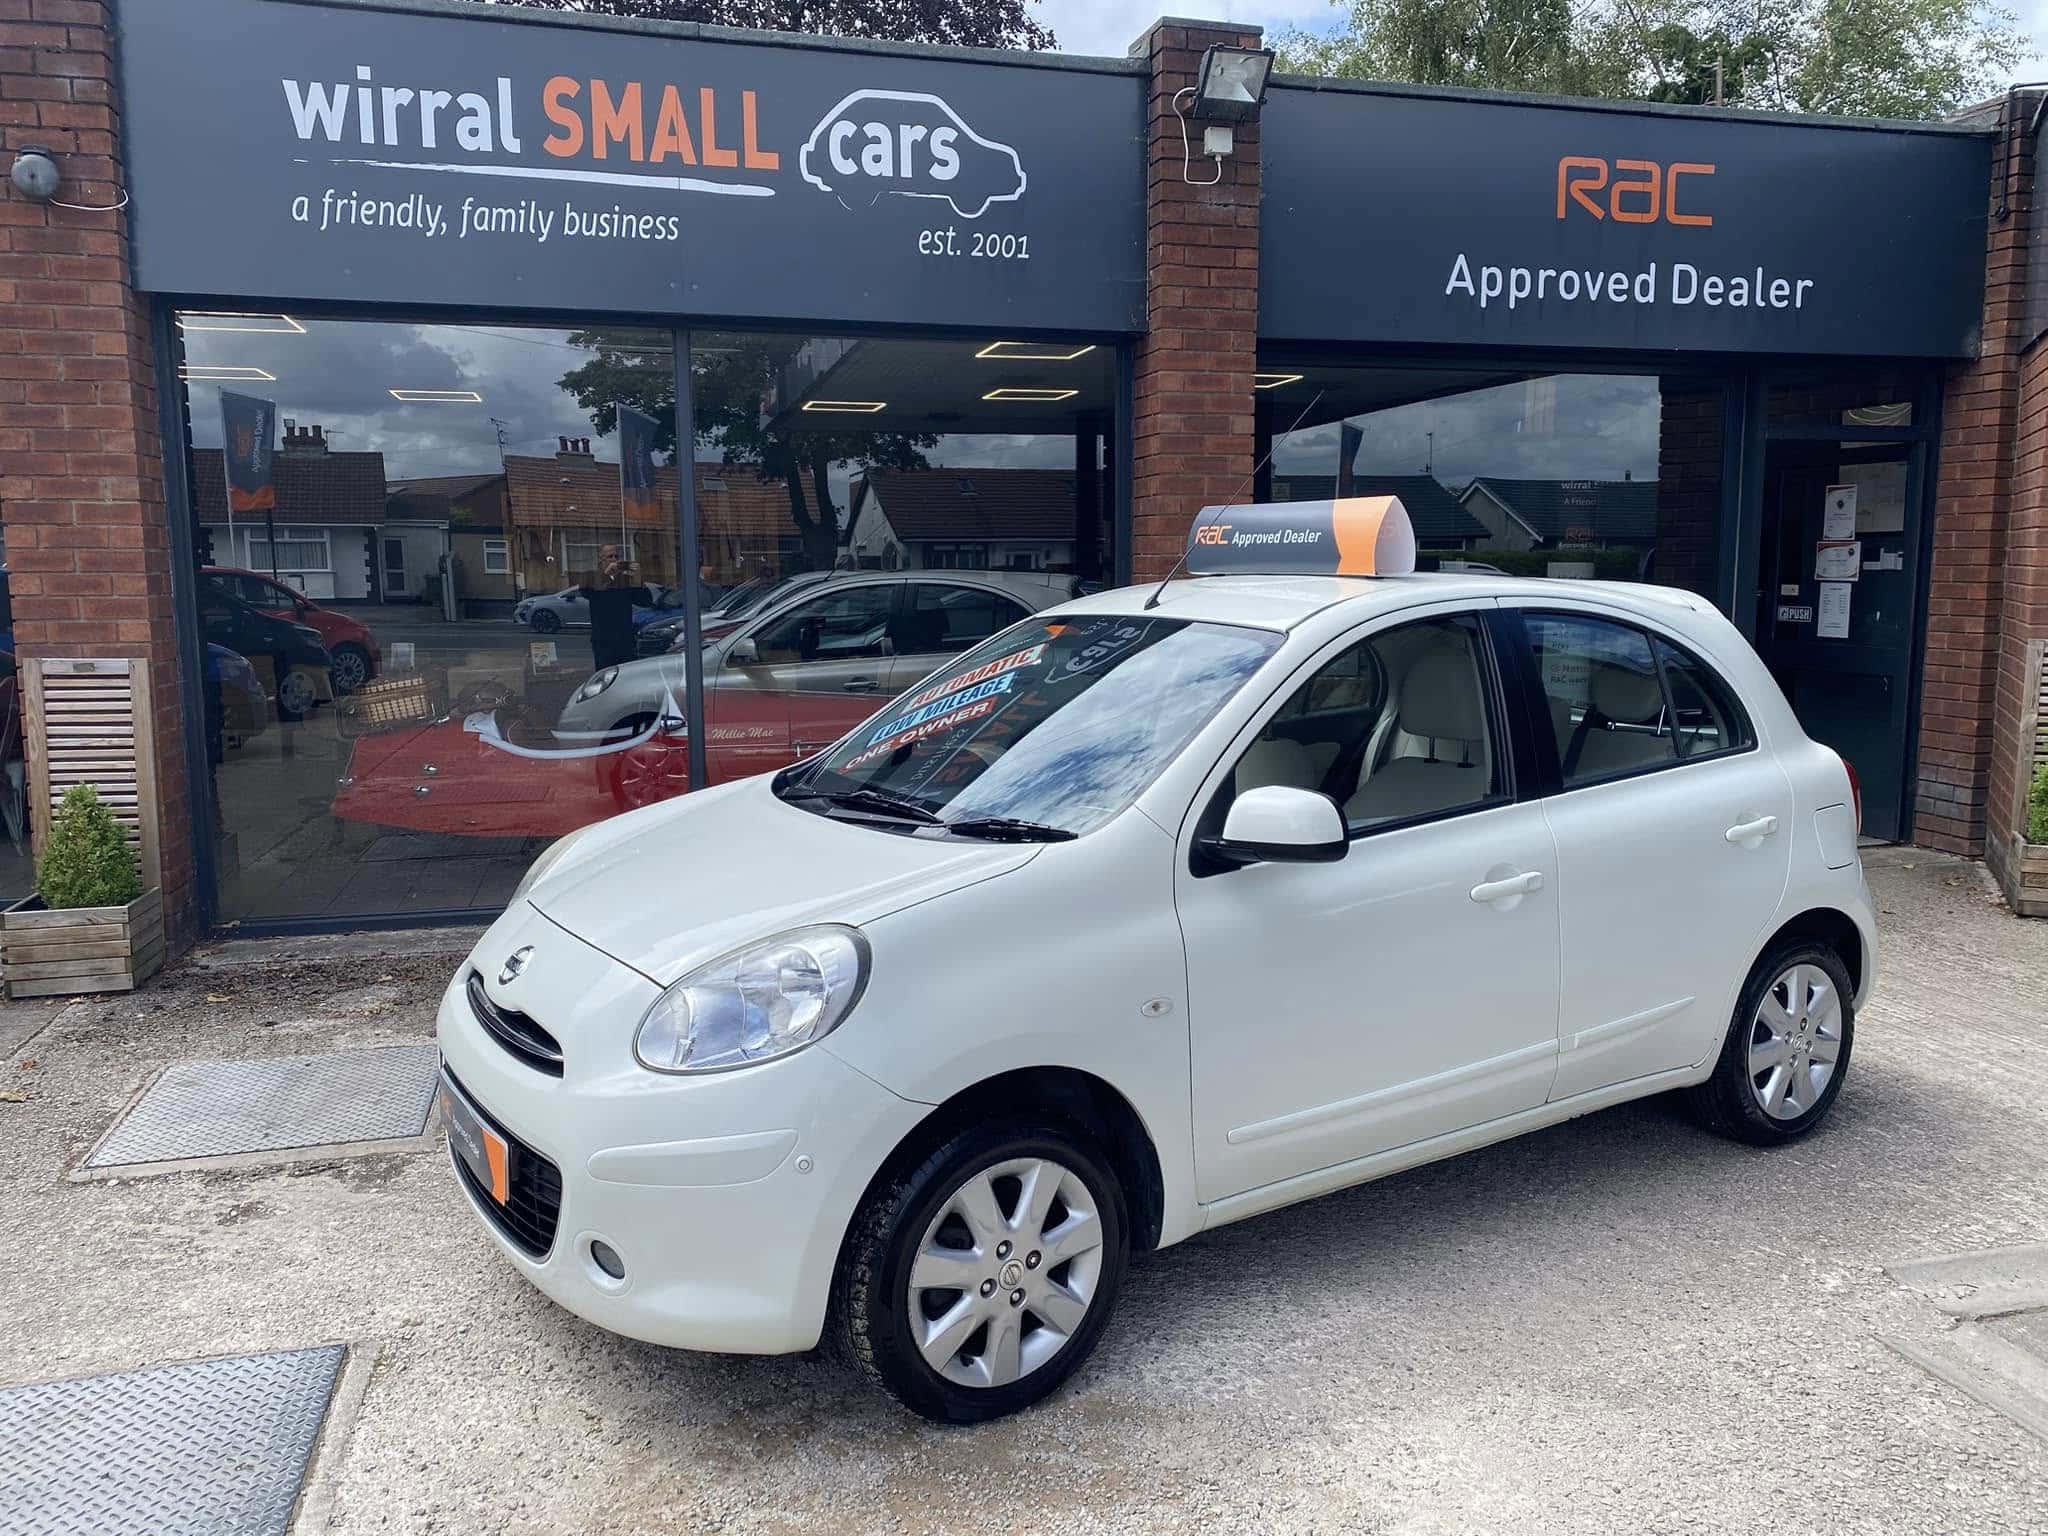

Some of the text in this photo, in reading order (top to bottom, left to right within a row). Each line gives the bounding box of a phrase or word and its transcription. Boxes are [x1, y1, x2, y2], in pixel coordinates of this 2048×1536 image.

[282, 65, 960, 179] wirral SMALL cars
[291, 189, 679, 243] a friendly, family business
[918, 227, 1030, 260] est. 2001
[1445, 253, 1814, 309] Approved Dealer
[1232, 530, 1281, 547] Approved
[1283, 529, 1321, 543] Dealer
[1789, 608, 1810, 620] PUSH
[911, 648, 1035, 708] AUTOMATIC
[711, 727, 746, 740] Millie
[845, 741, 895, 770] ONE
[899, 701, 990, 744] OWNER
[874, 676, 1007, 741] LOW MILEAGE
